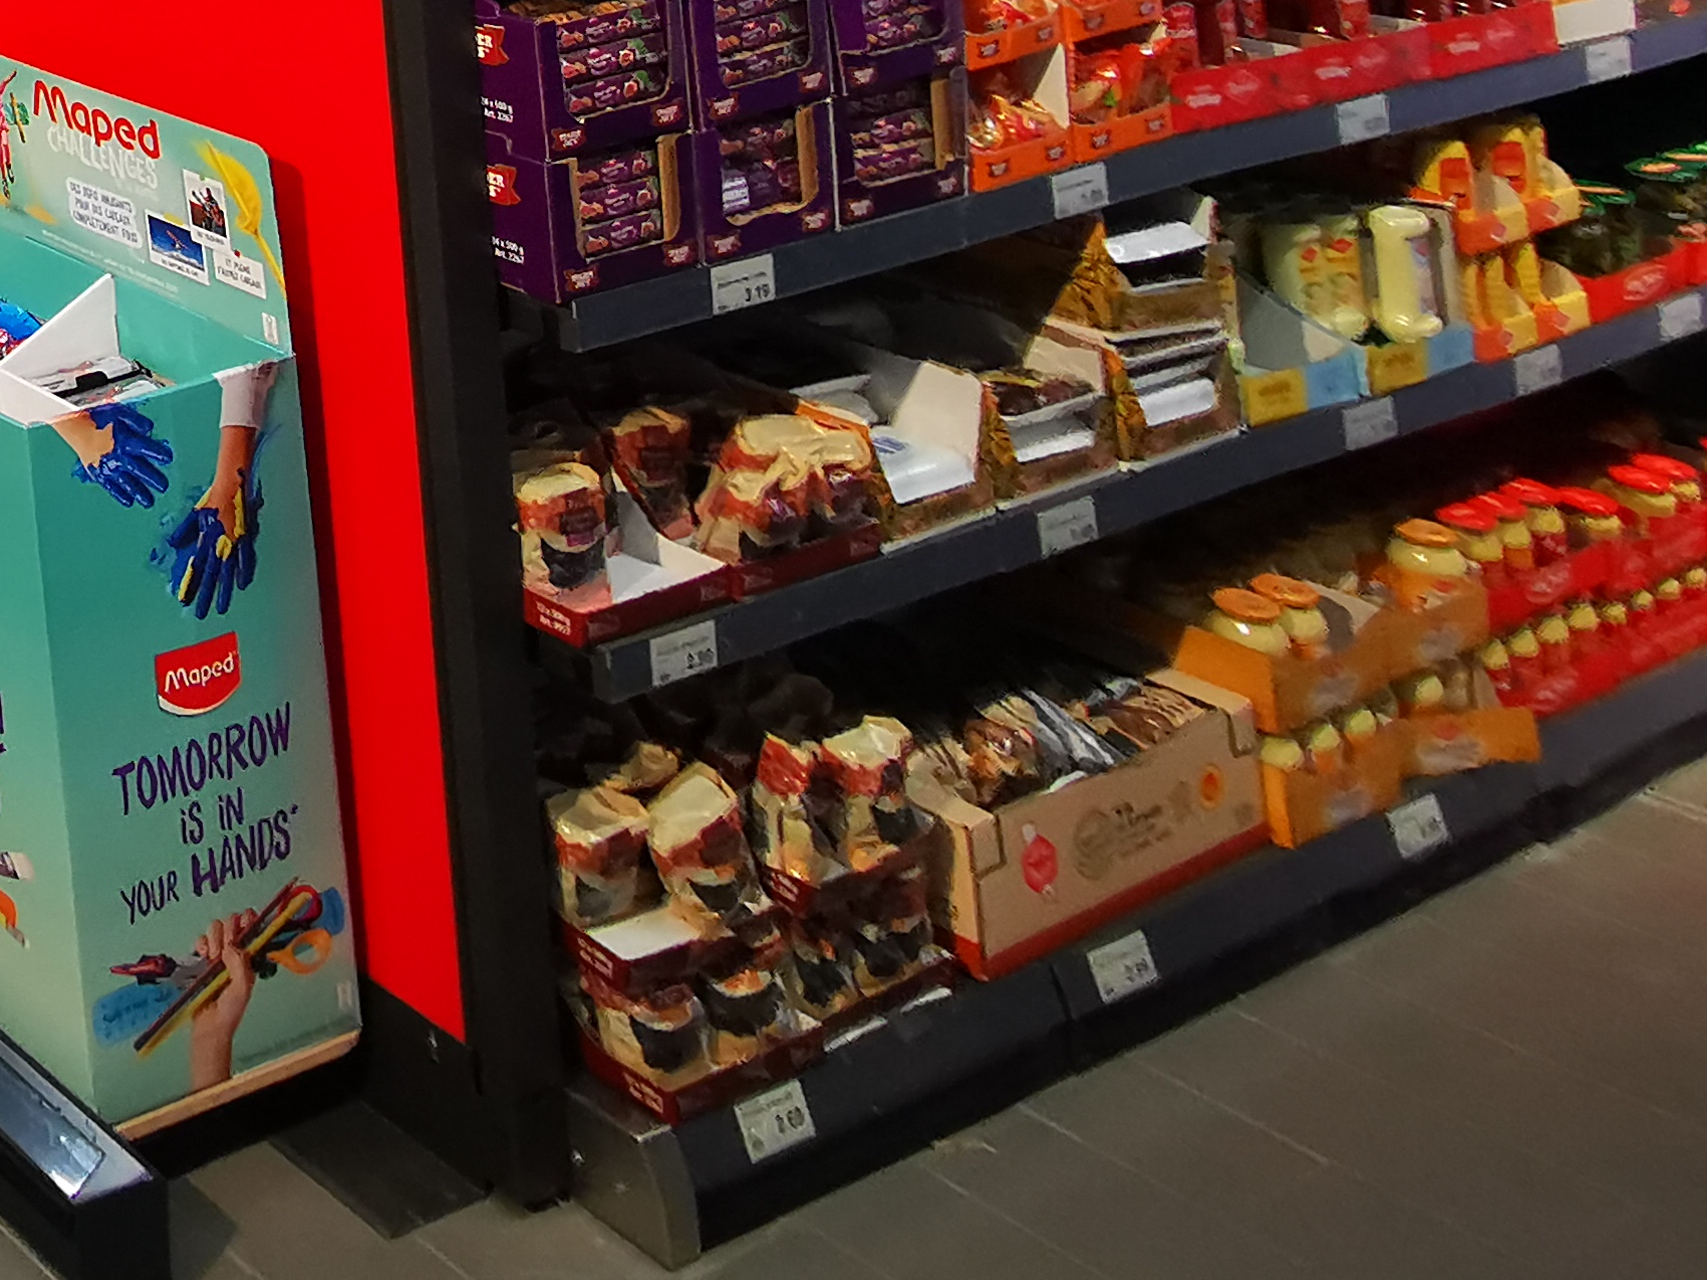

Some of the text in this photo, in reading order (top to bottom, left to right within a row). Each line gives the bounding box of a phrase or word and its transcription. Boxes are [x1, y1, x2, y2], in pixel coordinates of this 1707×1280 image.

[34, 80, 161, 159] Maped
[47, 125, 158, 189] CHALLENGES
[163, 652, 236, 694] Maped
[111, 700, 291, 816] TOMORROW
[120, 870, 180, 926] YOUR
